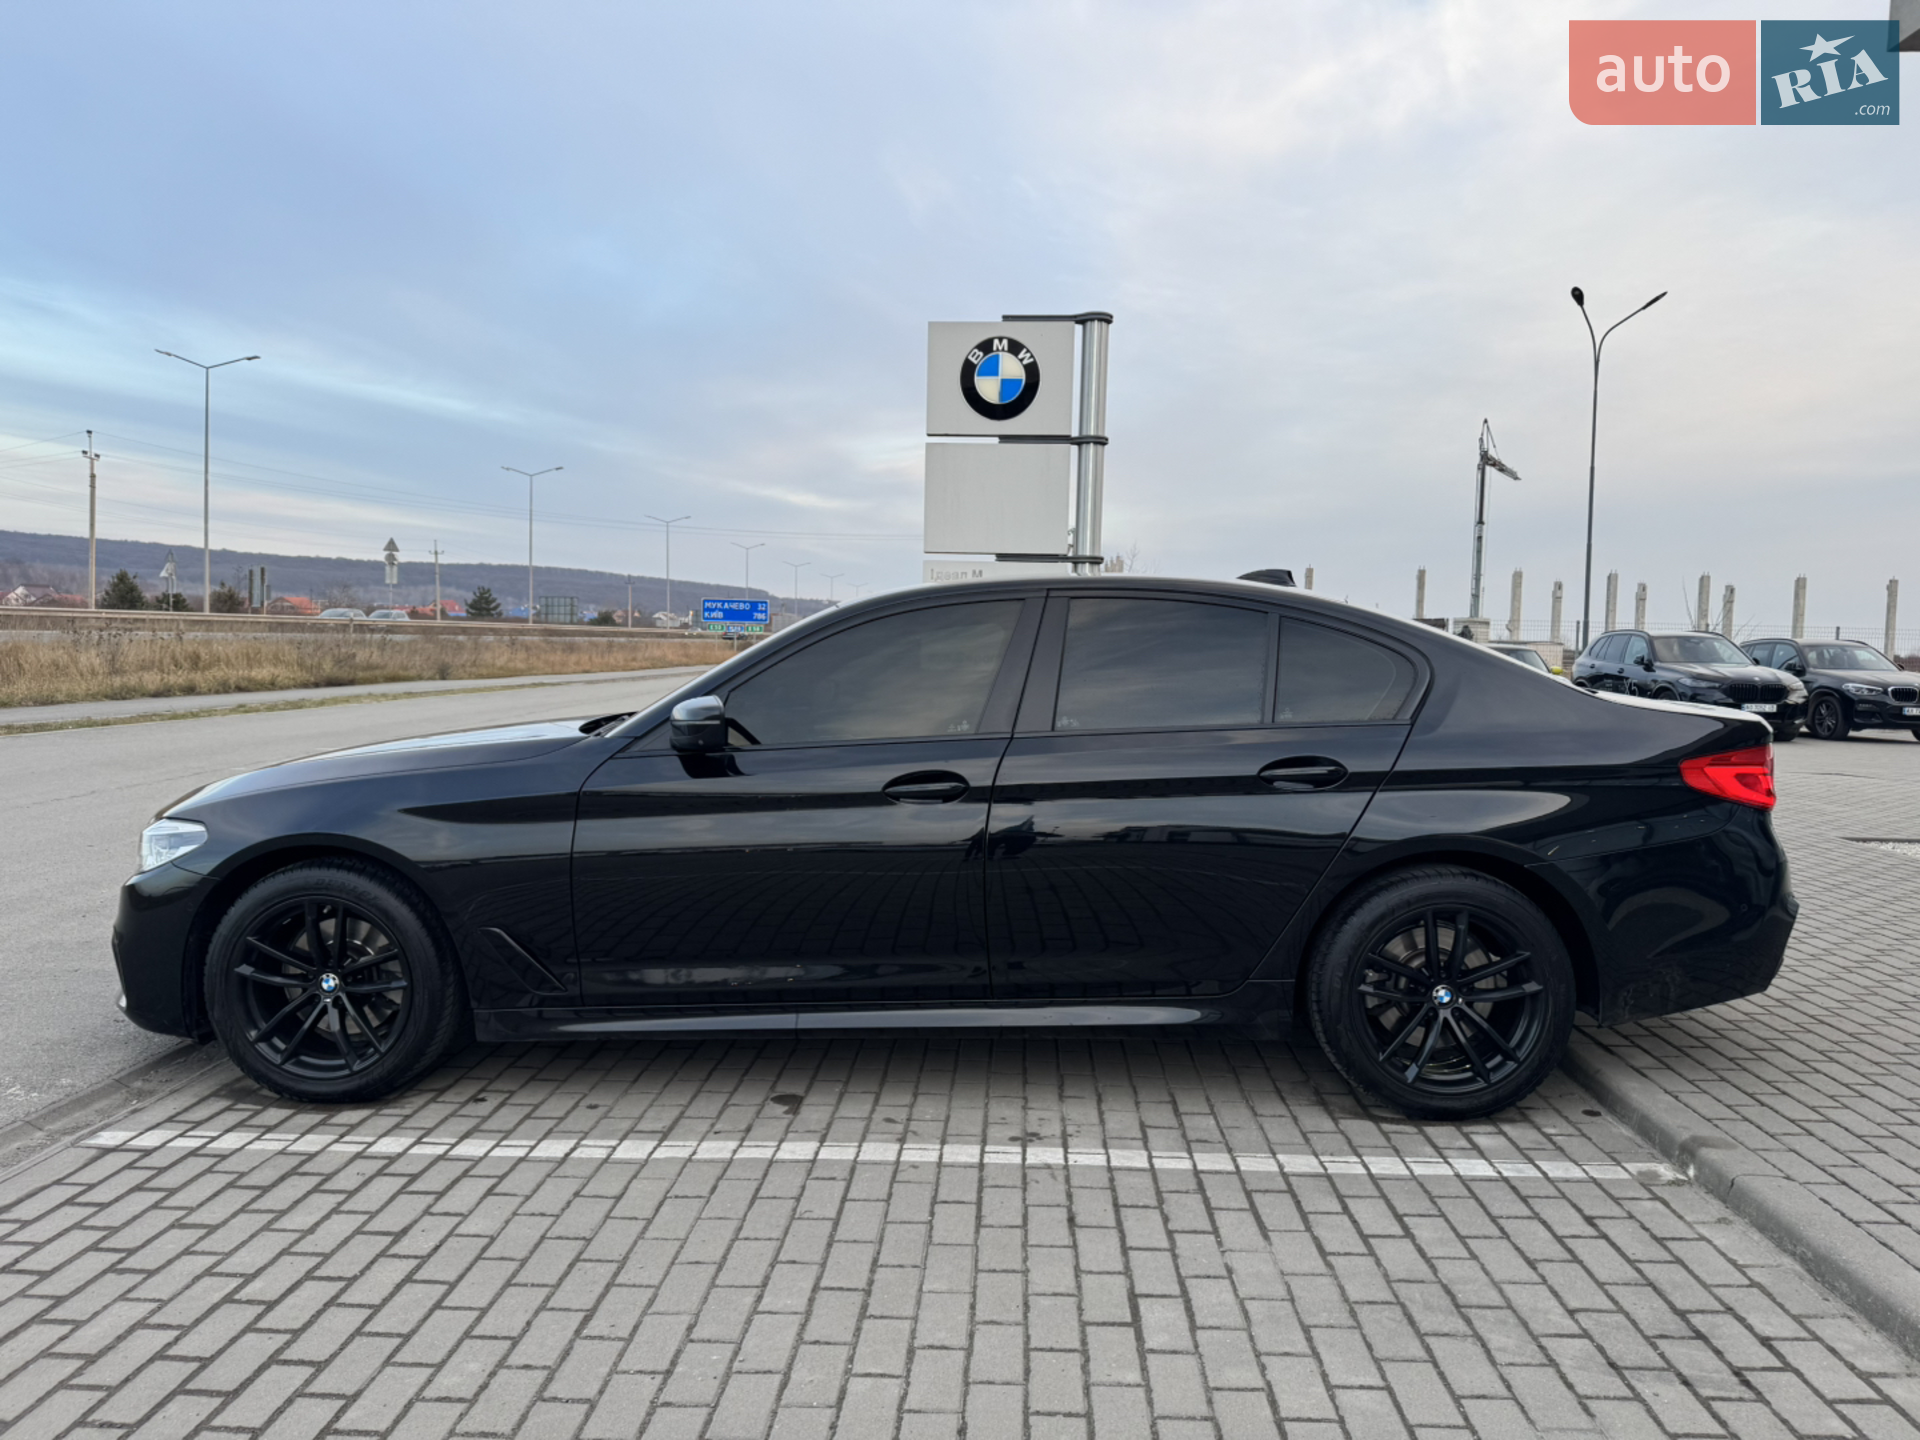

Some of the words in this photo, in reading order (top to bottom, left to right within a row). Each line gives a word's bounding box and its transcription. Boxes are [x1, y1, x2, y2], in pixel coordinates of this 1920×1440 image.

[967, 338, 1034, 366] BMW
[704, 602, 751, 611] МУКАЧЕВО
[757, 603, 767, 611] 32
[704, 610, 724, 619] КИЇВ
[1623, 678, 1640, 697] X5
